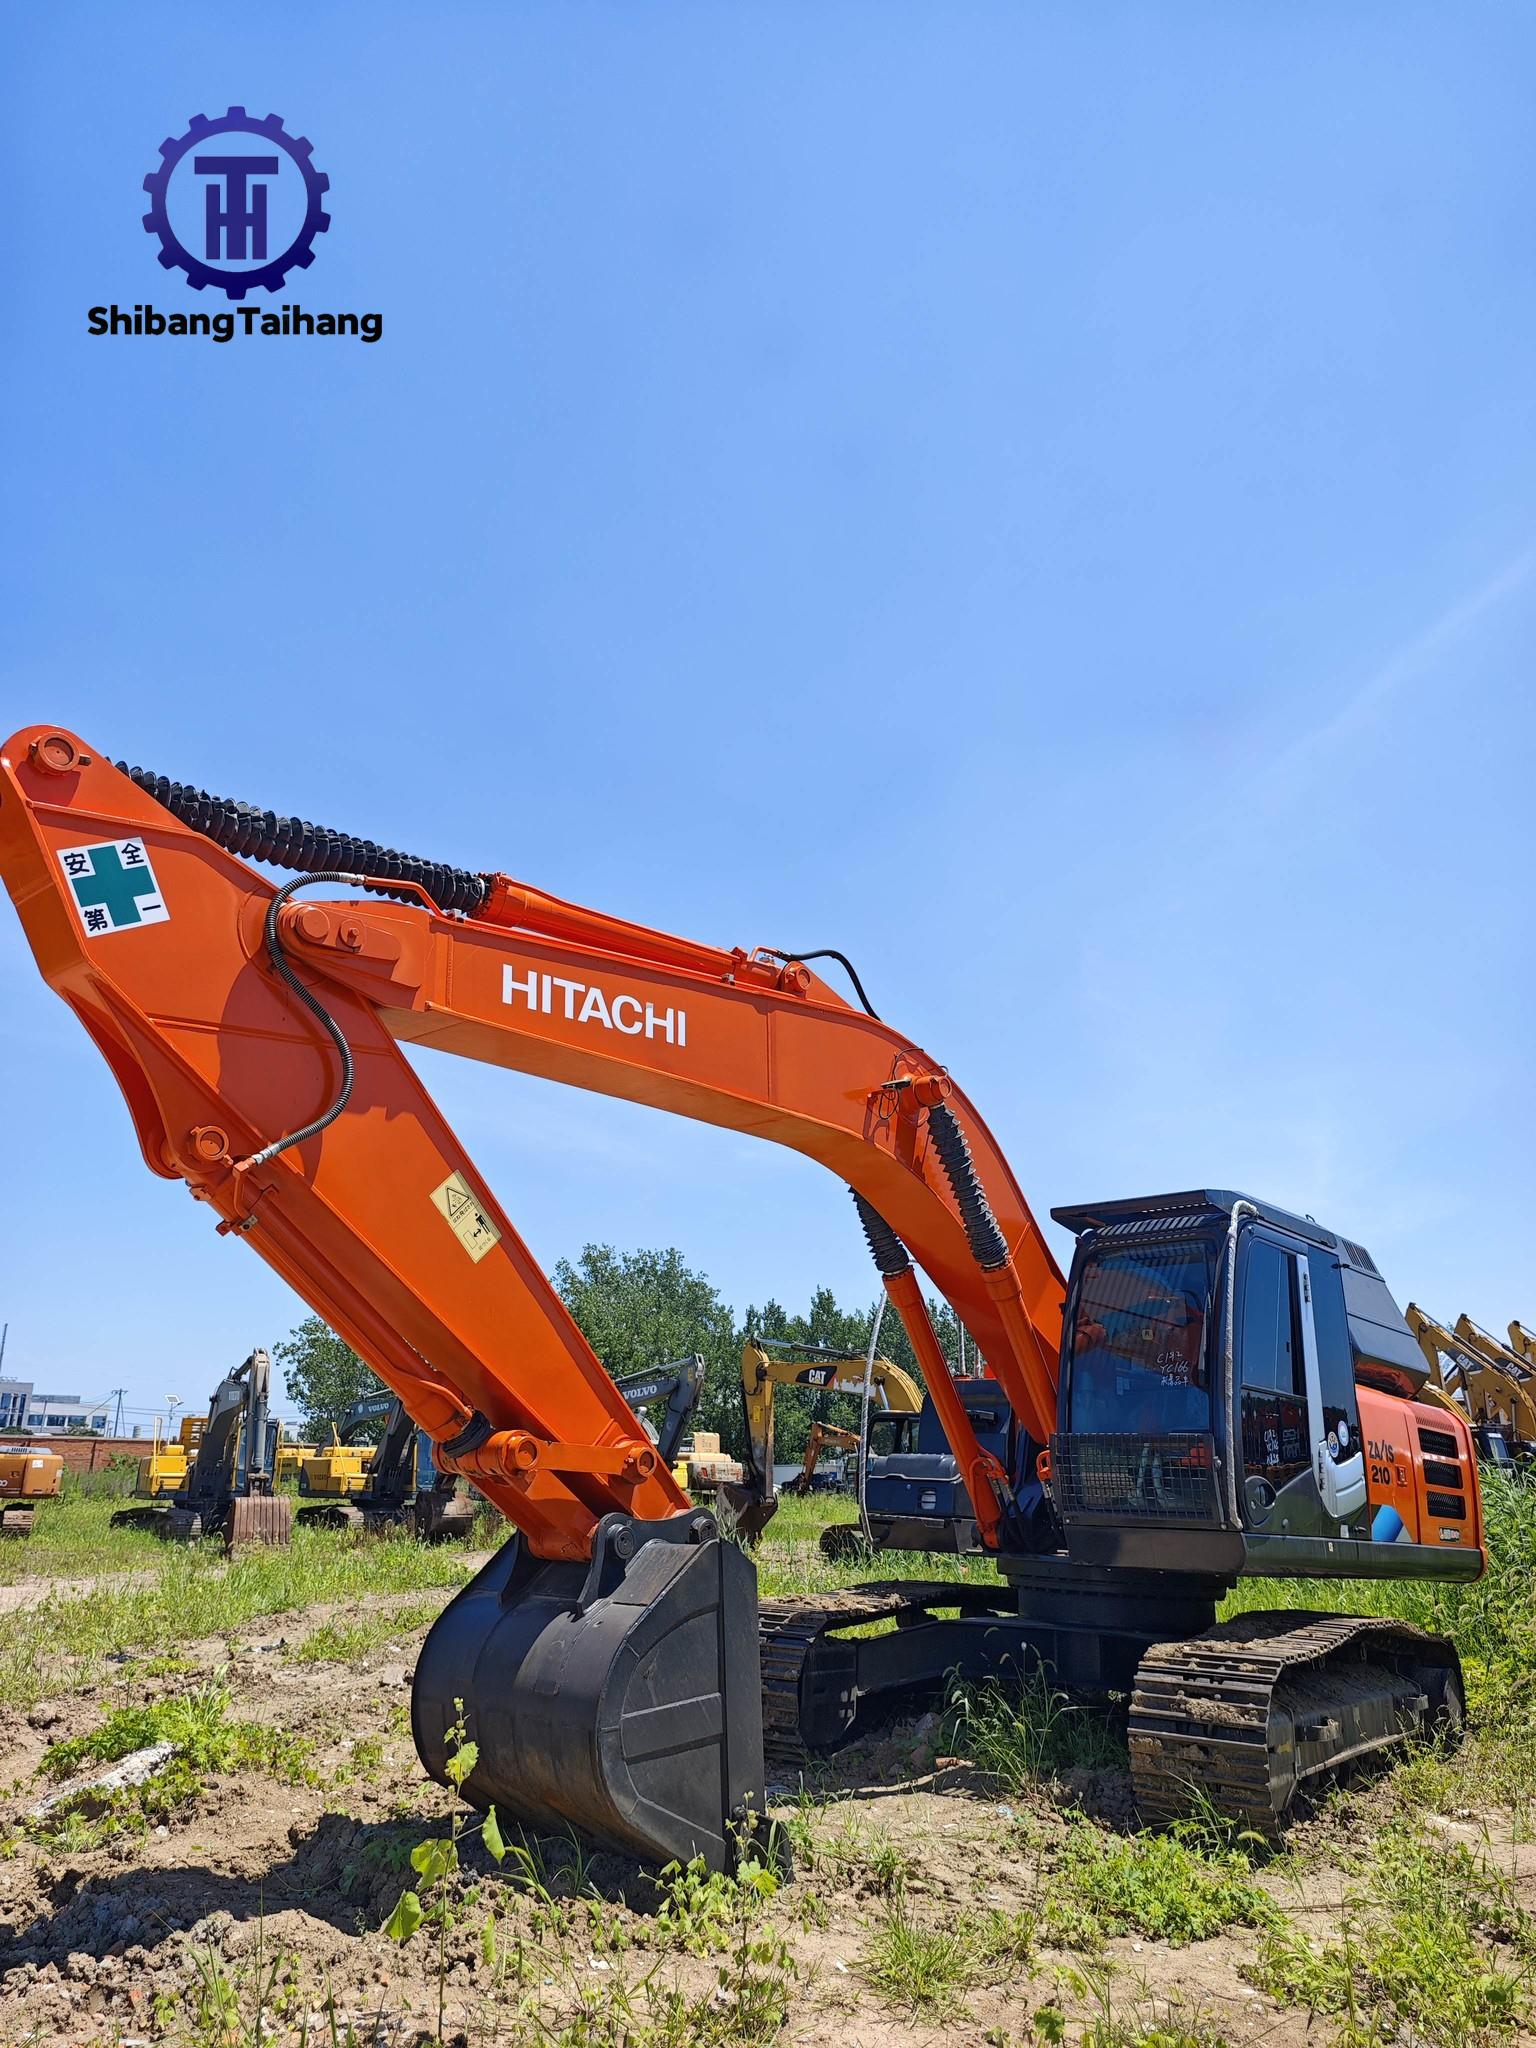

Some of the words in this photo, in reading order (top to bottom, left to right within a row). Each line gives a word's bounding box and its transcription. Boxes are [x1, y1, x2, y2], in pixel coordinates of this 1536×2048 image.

[502, 963, 686, 1047] HITACHI
[1456, 1353, 1475, 1371] CAT
[1506, 1362, 1523, 1378] CAT
[808, 1369, 827, 1385] CAT
[622, 1384, 658, 1400] VOLVO
[1371, 1464, 1391, 1486] 210
